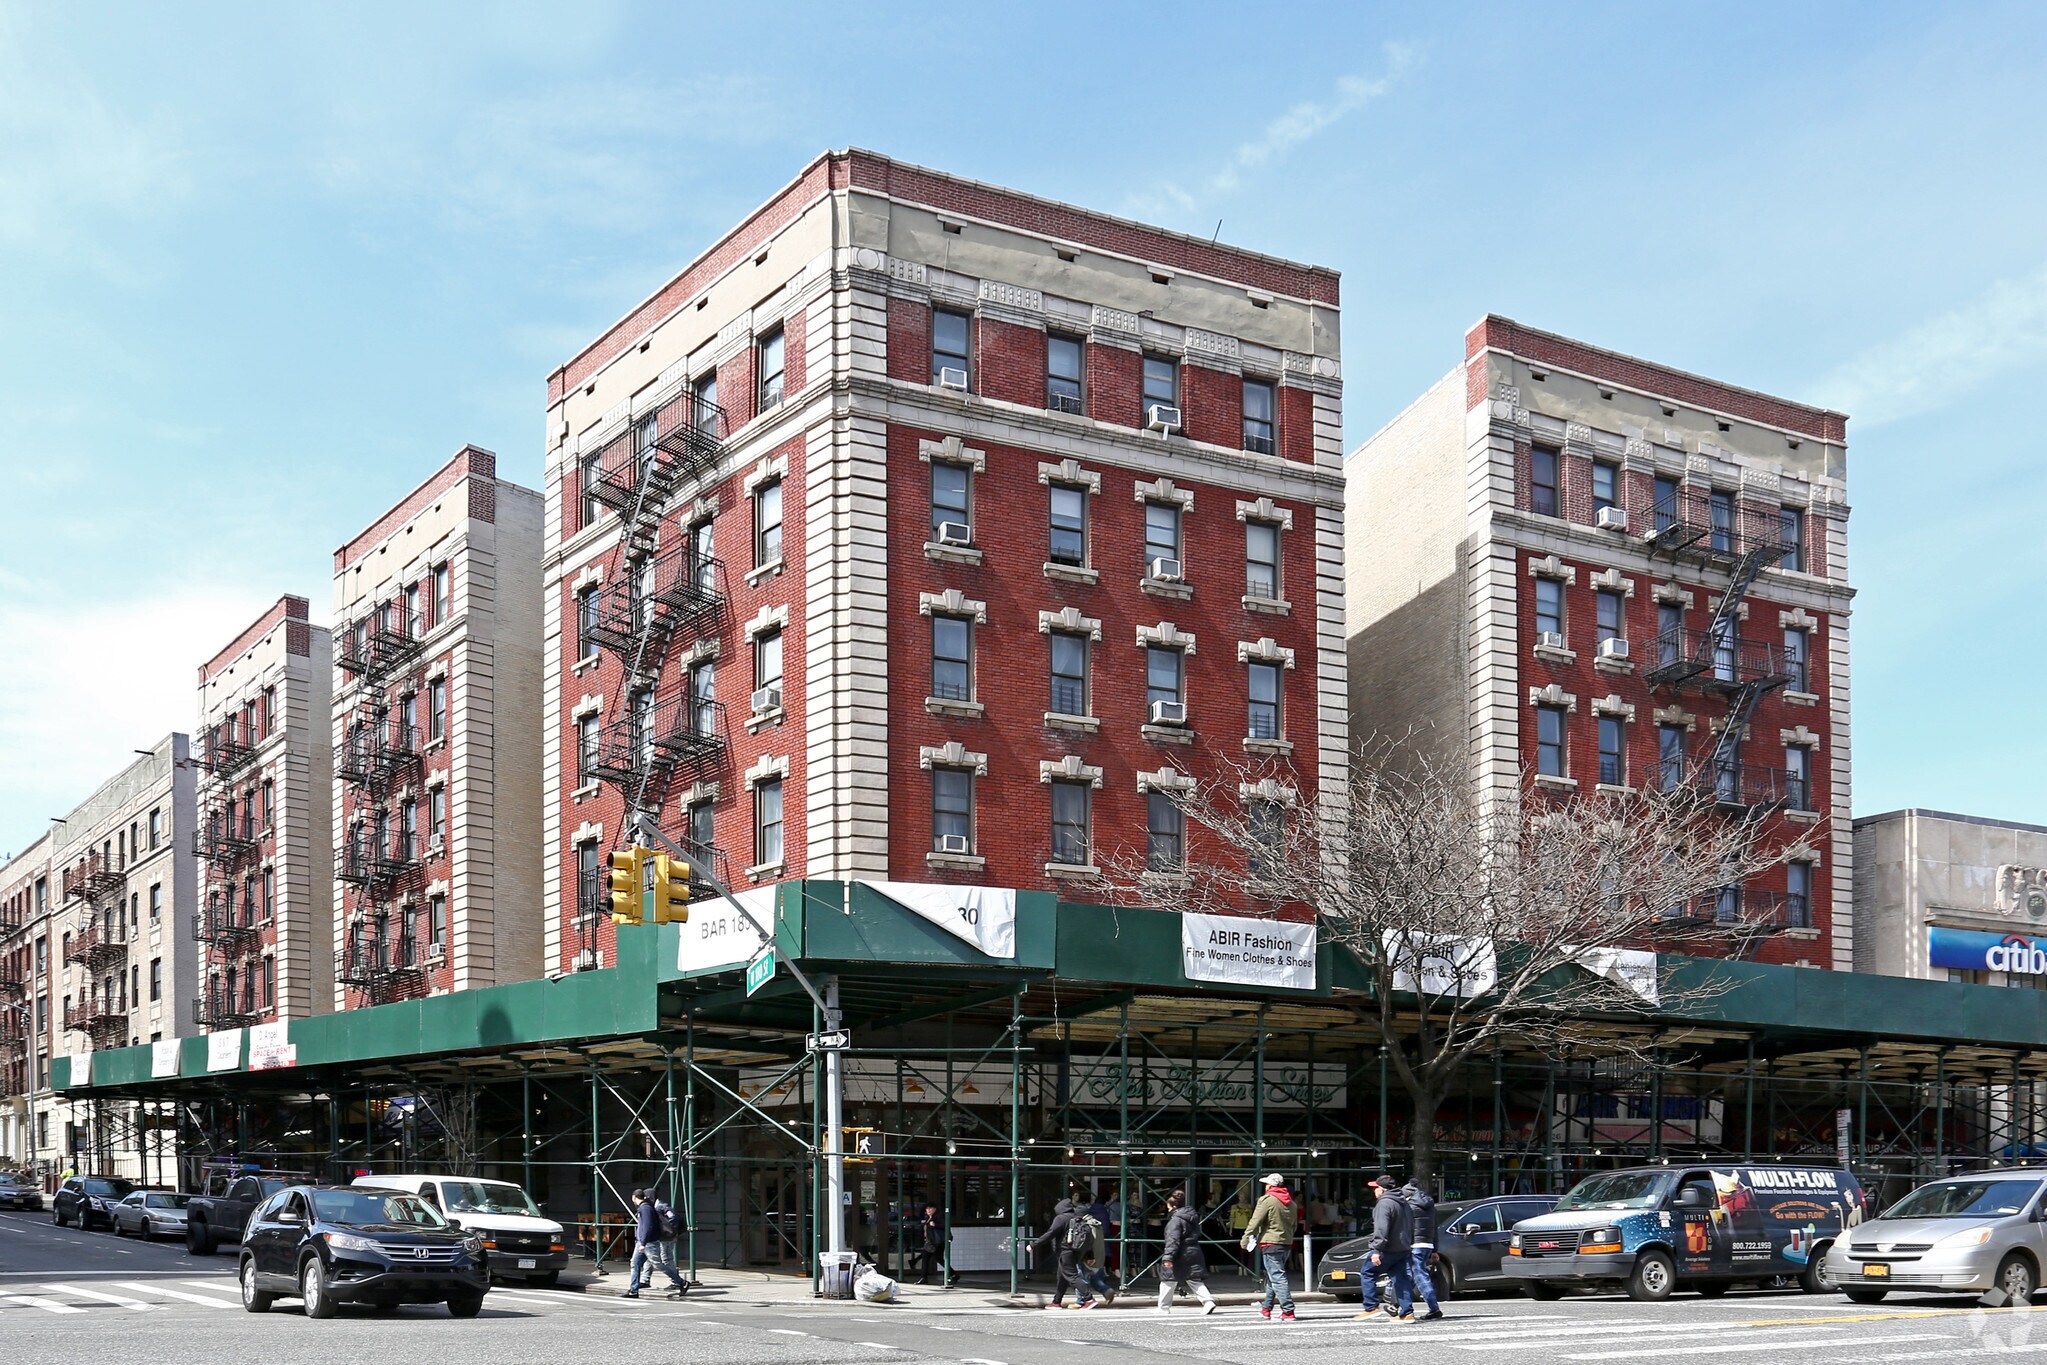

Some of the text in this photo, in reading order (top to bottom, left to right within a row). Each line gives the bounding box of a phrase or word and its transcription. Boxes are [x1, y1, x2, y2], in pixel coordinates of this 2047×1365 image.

[701, 918, 727, 940] BAR
[1208, 930, 1292, 951] ABIR Fashion
[1186, 947, 1313, 968] Fine Women Clothes & Shoes
[1985, 940, 2047, 975] citib
[1748, 1170, 1837, 1188] MULTI-FLOW
